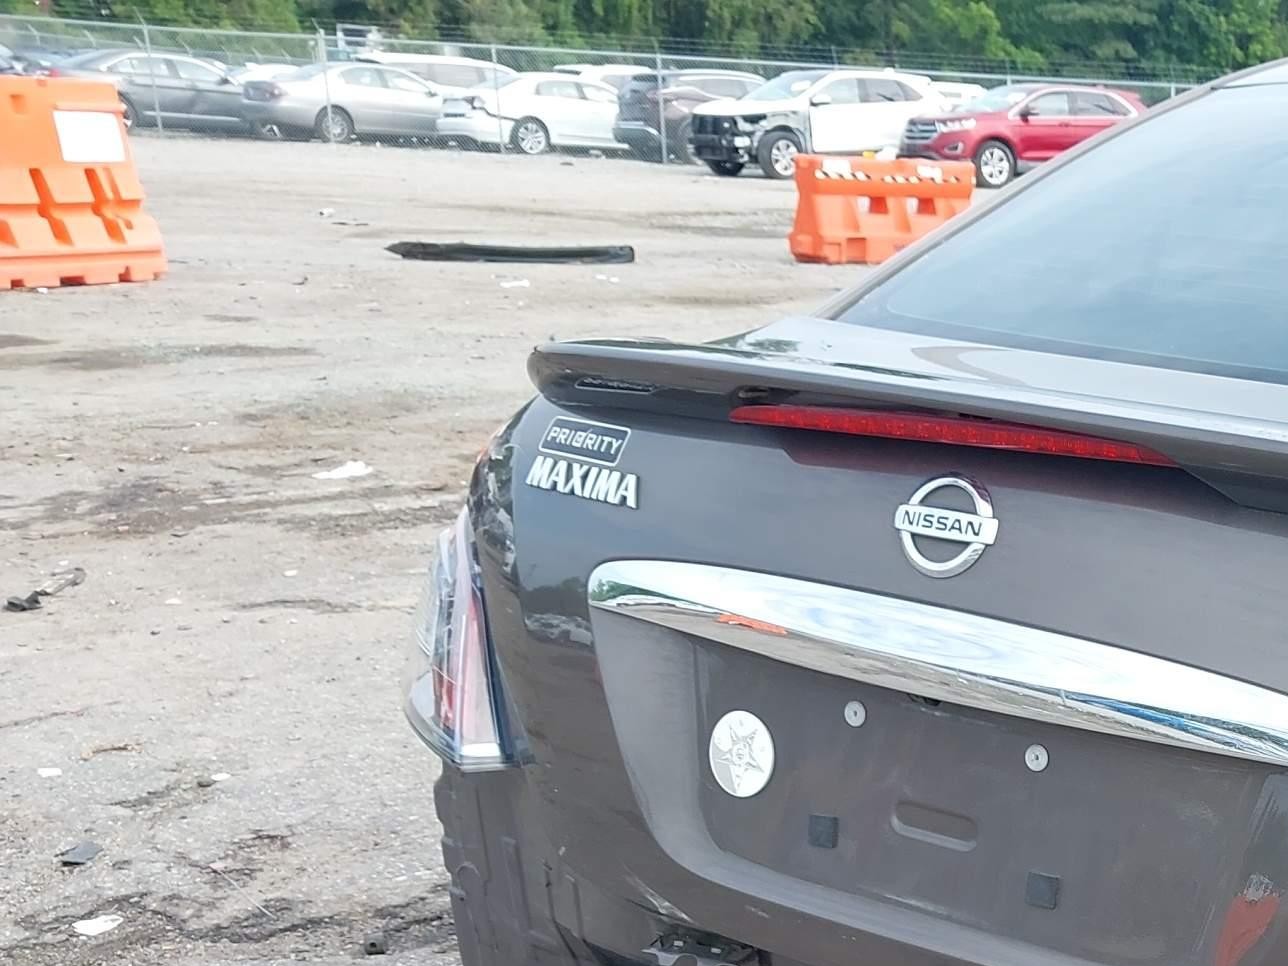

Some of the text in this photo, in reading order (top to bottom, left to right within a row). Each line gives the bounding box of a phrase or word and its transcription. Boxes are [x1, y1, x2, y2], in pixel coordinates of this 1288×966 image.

[547, 426, 623, 455] PRIORITY
[525, 455, 639, 509] MAXIMA
[902, 509, 982, 537] NISSAN
